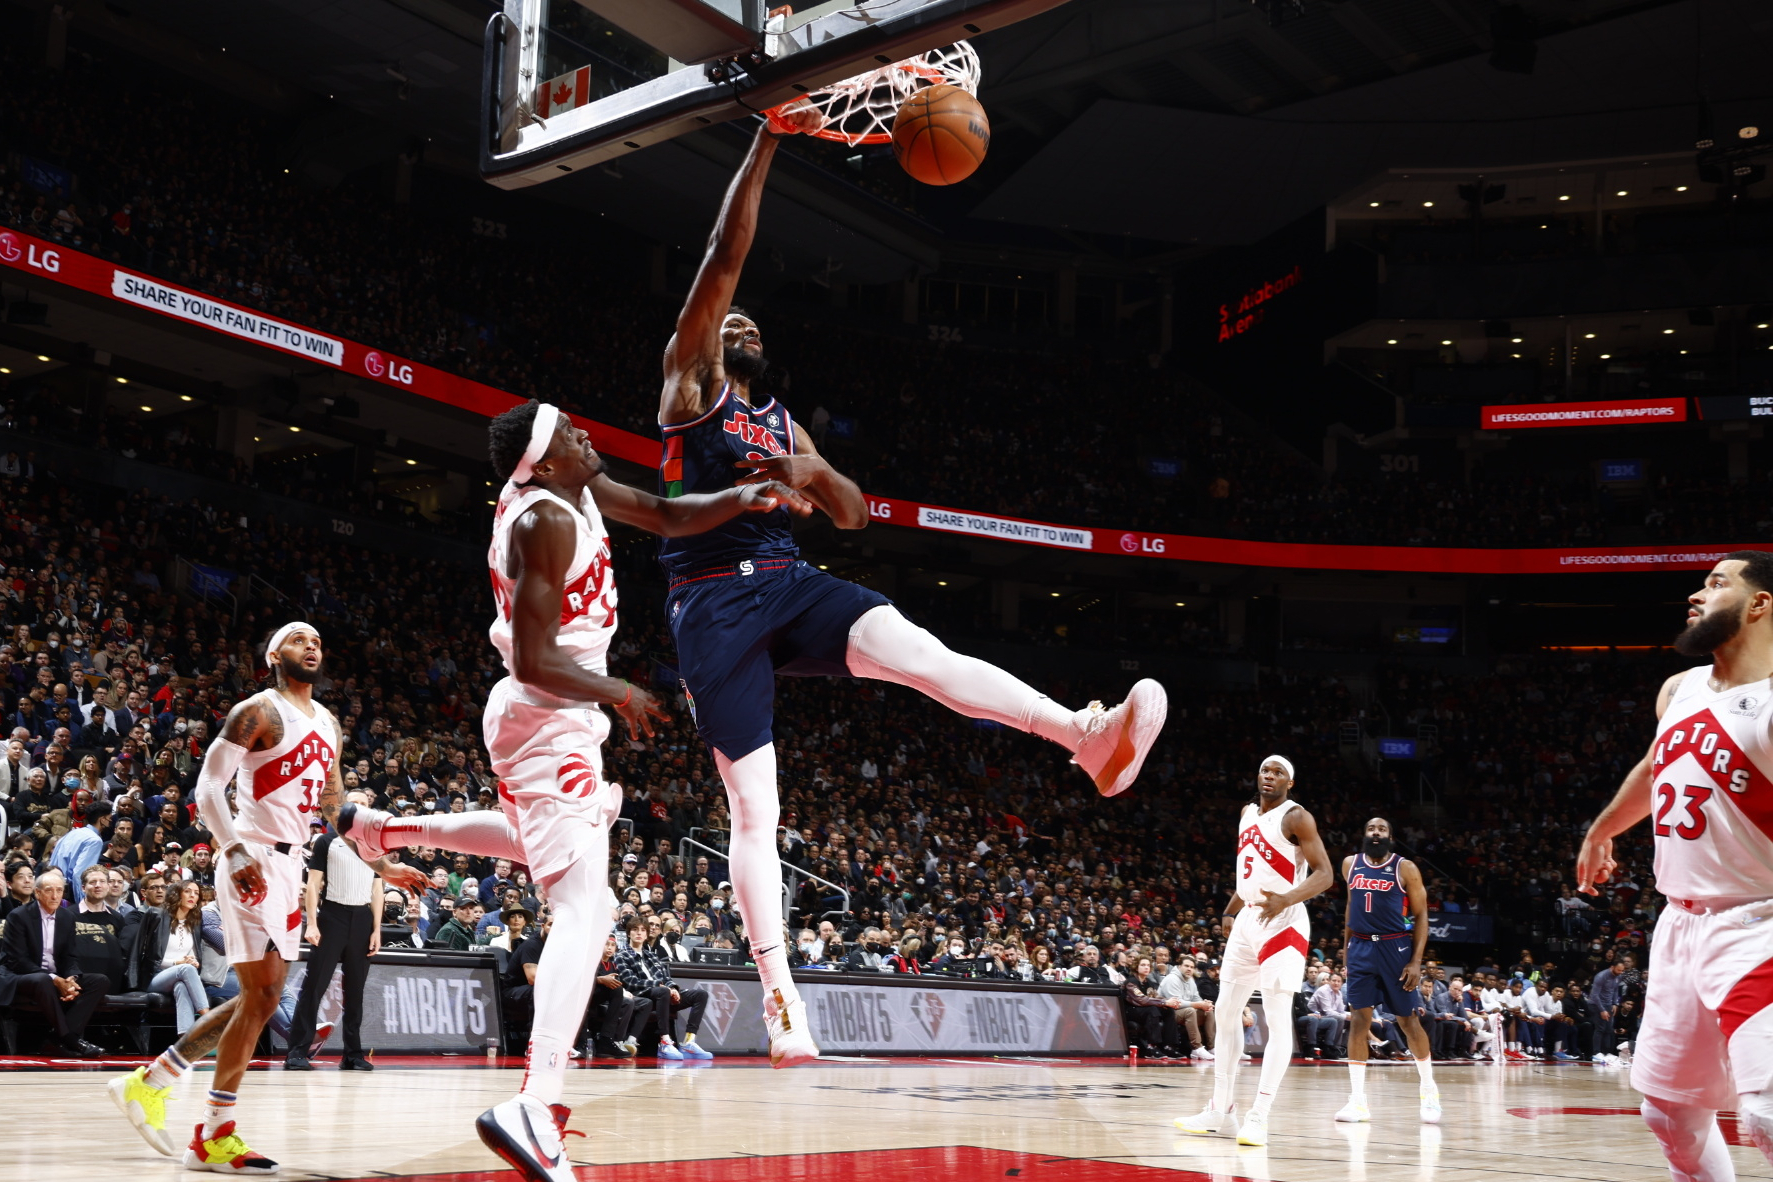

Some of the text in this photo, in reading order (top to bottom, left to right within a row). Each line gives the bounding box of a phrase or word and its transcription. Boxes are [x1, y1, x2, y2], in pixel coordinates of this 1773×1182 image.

[28, 244, 60, 273] LG
[124, 279, 334, 357] SHARE YOUR FAN FIT TO WIN
[388, 361, 413, 385] LG
[1491, 407, 1676, 422] LIFESGOODMOMENT.COM/RAPTORS
[1380, 454, 1419, 473] 301
[870, 500, 892, 518] LG
[331, 518, 355, 536] 120
[926, 511, 1084, 544] SHARE YOUR FAN FIT TO WIN
[1142, 537, 1165, 553] LG
[1559, 553, 1730, 565] LIFESGOODMOMENT.COM/RAPT
[280, 739, 334, 776] RAPTOR
[1653, 722, 1750, 794] APTORS
[1655, 782, 1713, 841] 23
[1238, 829, 1273, 860] APTORS
[1243, 856, 1254, 879] 5
[1349, 873, 1395, 892] Sixers
[1363, 891, 1372, 913] 1
[383, 976, 487, 1036] #NBA75
[816, 990, 893, 1043] #NBA75
[965, 996, 1031, 1044] #NBA75
